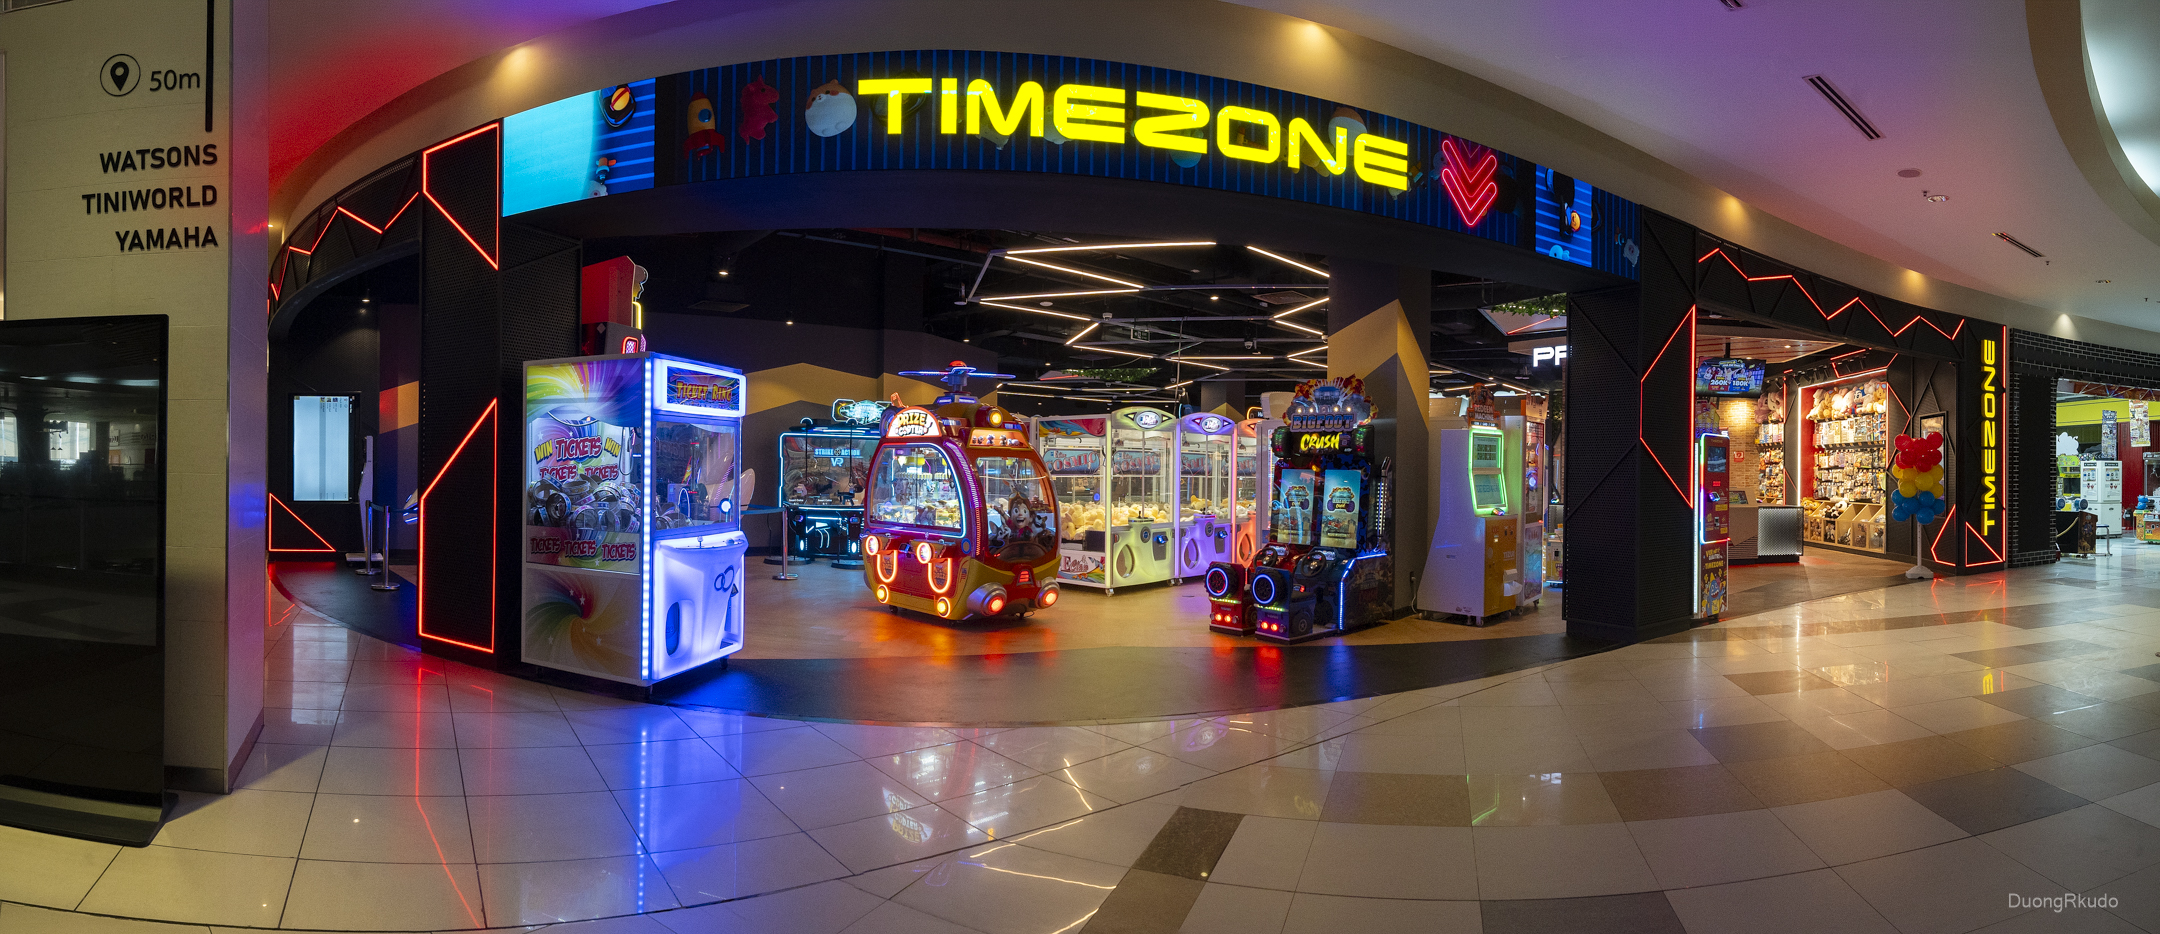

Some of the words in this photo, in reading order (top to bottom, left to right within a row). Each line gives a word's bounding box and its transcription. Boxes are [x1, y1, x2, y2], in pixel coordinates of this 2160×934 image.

[149, 69, 200, 91] 50m
[858, 78, 1408, 191] TIMEZONE
[100, 144, 218, 174] WATSONS
[82, 185, 217, 215] TINIWORLD
[115, 226, 218, 252] YAMAHA
[676, 381, 708, 400] TICKET
[712, 384, 732, 402] RING
[897, 412, 926, 428] PRIZE
[1292, 413, 1354, 431] BIGFOOT
[1300, 432, 1342, 451] CRUSH
[1981, 339, 1996, 536] TIMEZONE
[534, 440, 553, 464] WIN
[555, 436, 603, 461] TICKETS
[604, 437, 621, 458] WIN
[814, 448, 834, 456] STRIKE
[830, 457, 844, 467] VR
[530, 537, 561, 554] TICKETS
[564, 540, 597, 557] TICKETS
[601, 543, 636, 561] TICKETS
